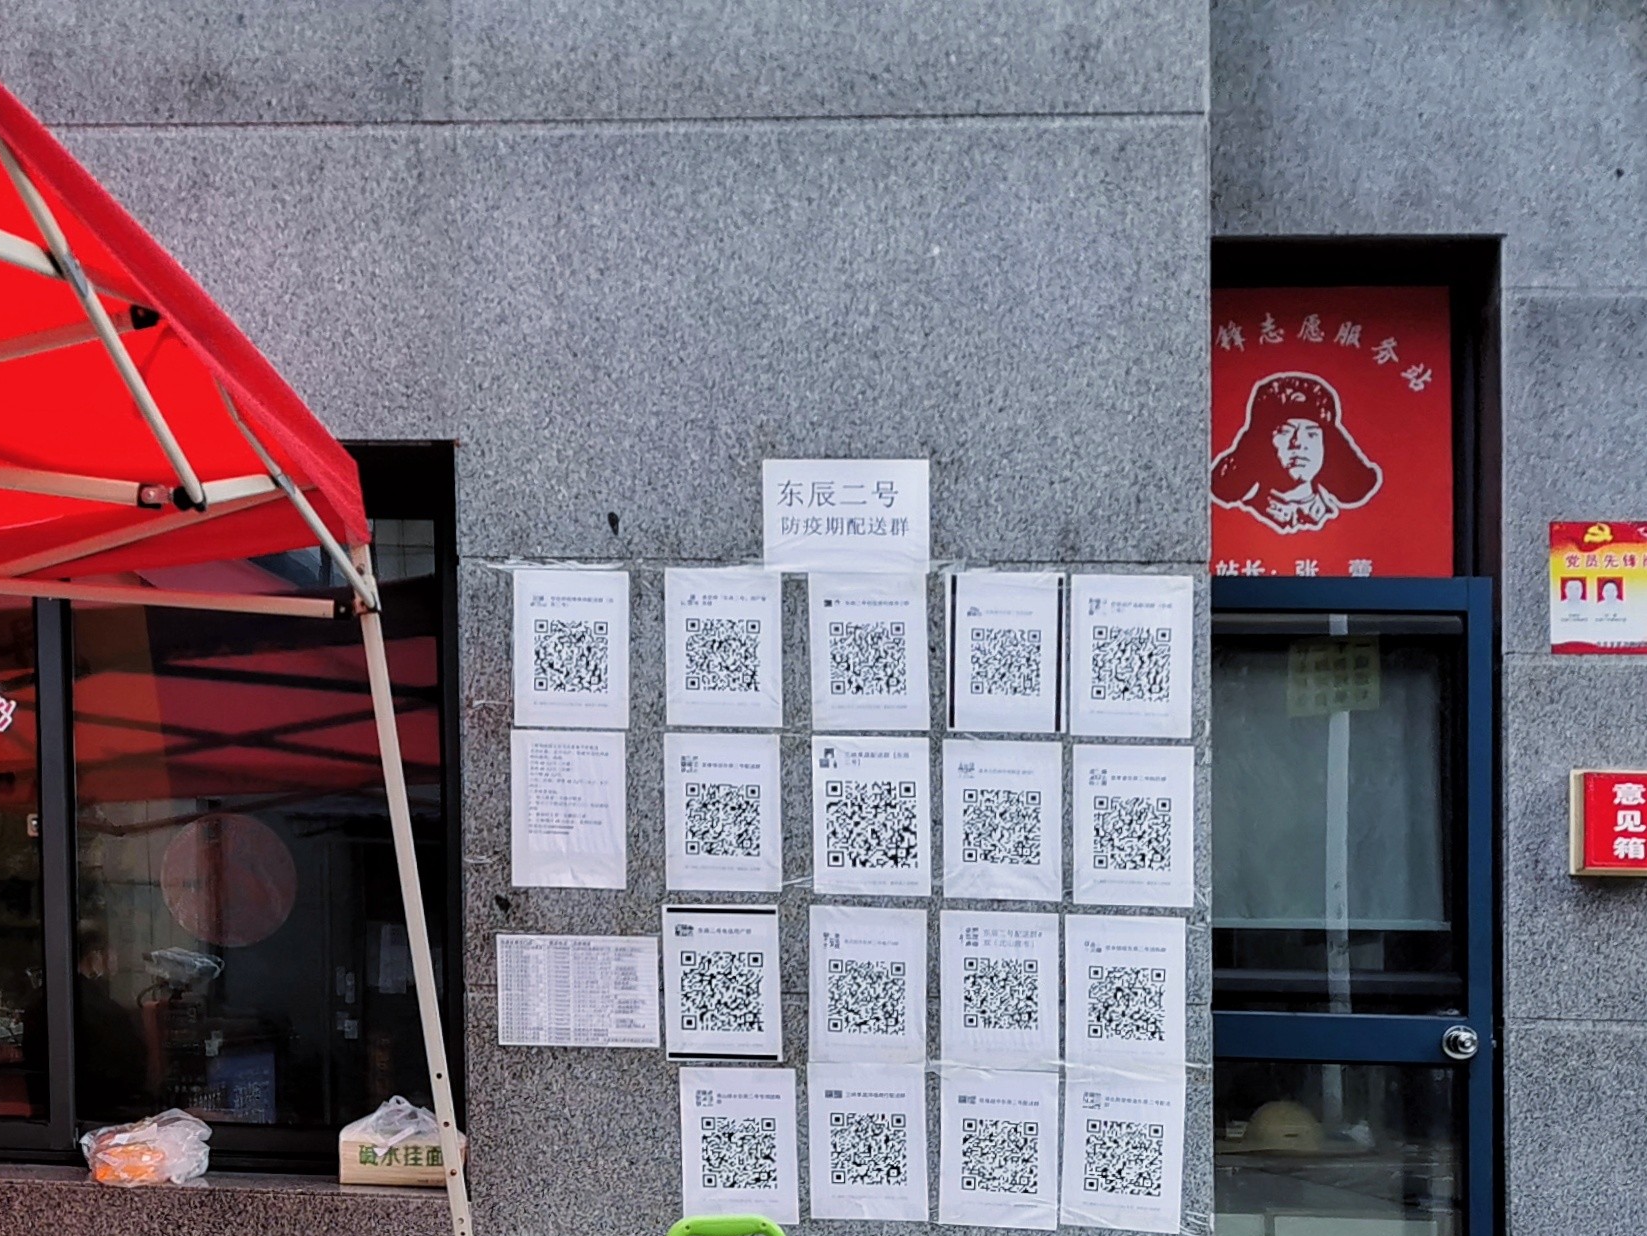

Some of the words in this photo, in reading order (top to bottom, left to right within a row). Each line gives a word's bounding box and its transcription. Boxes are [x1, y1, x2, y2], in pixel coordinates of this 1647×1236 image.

[776, 478, 900, 509] 东辰二号
[780, 515, 911, 537] 防疫期配送群
[1565, 552, 1647, 570] 党员先锋
[1611, 782, 1647, 860] 意见箱
